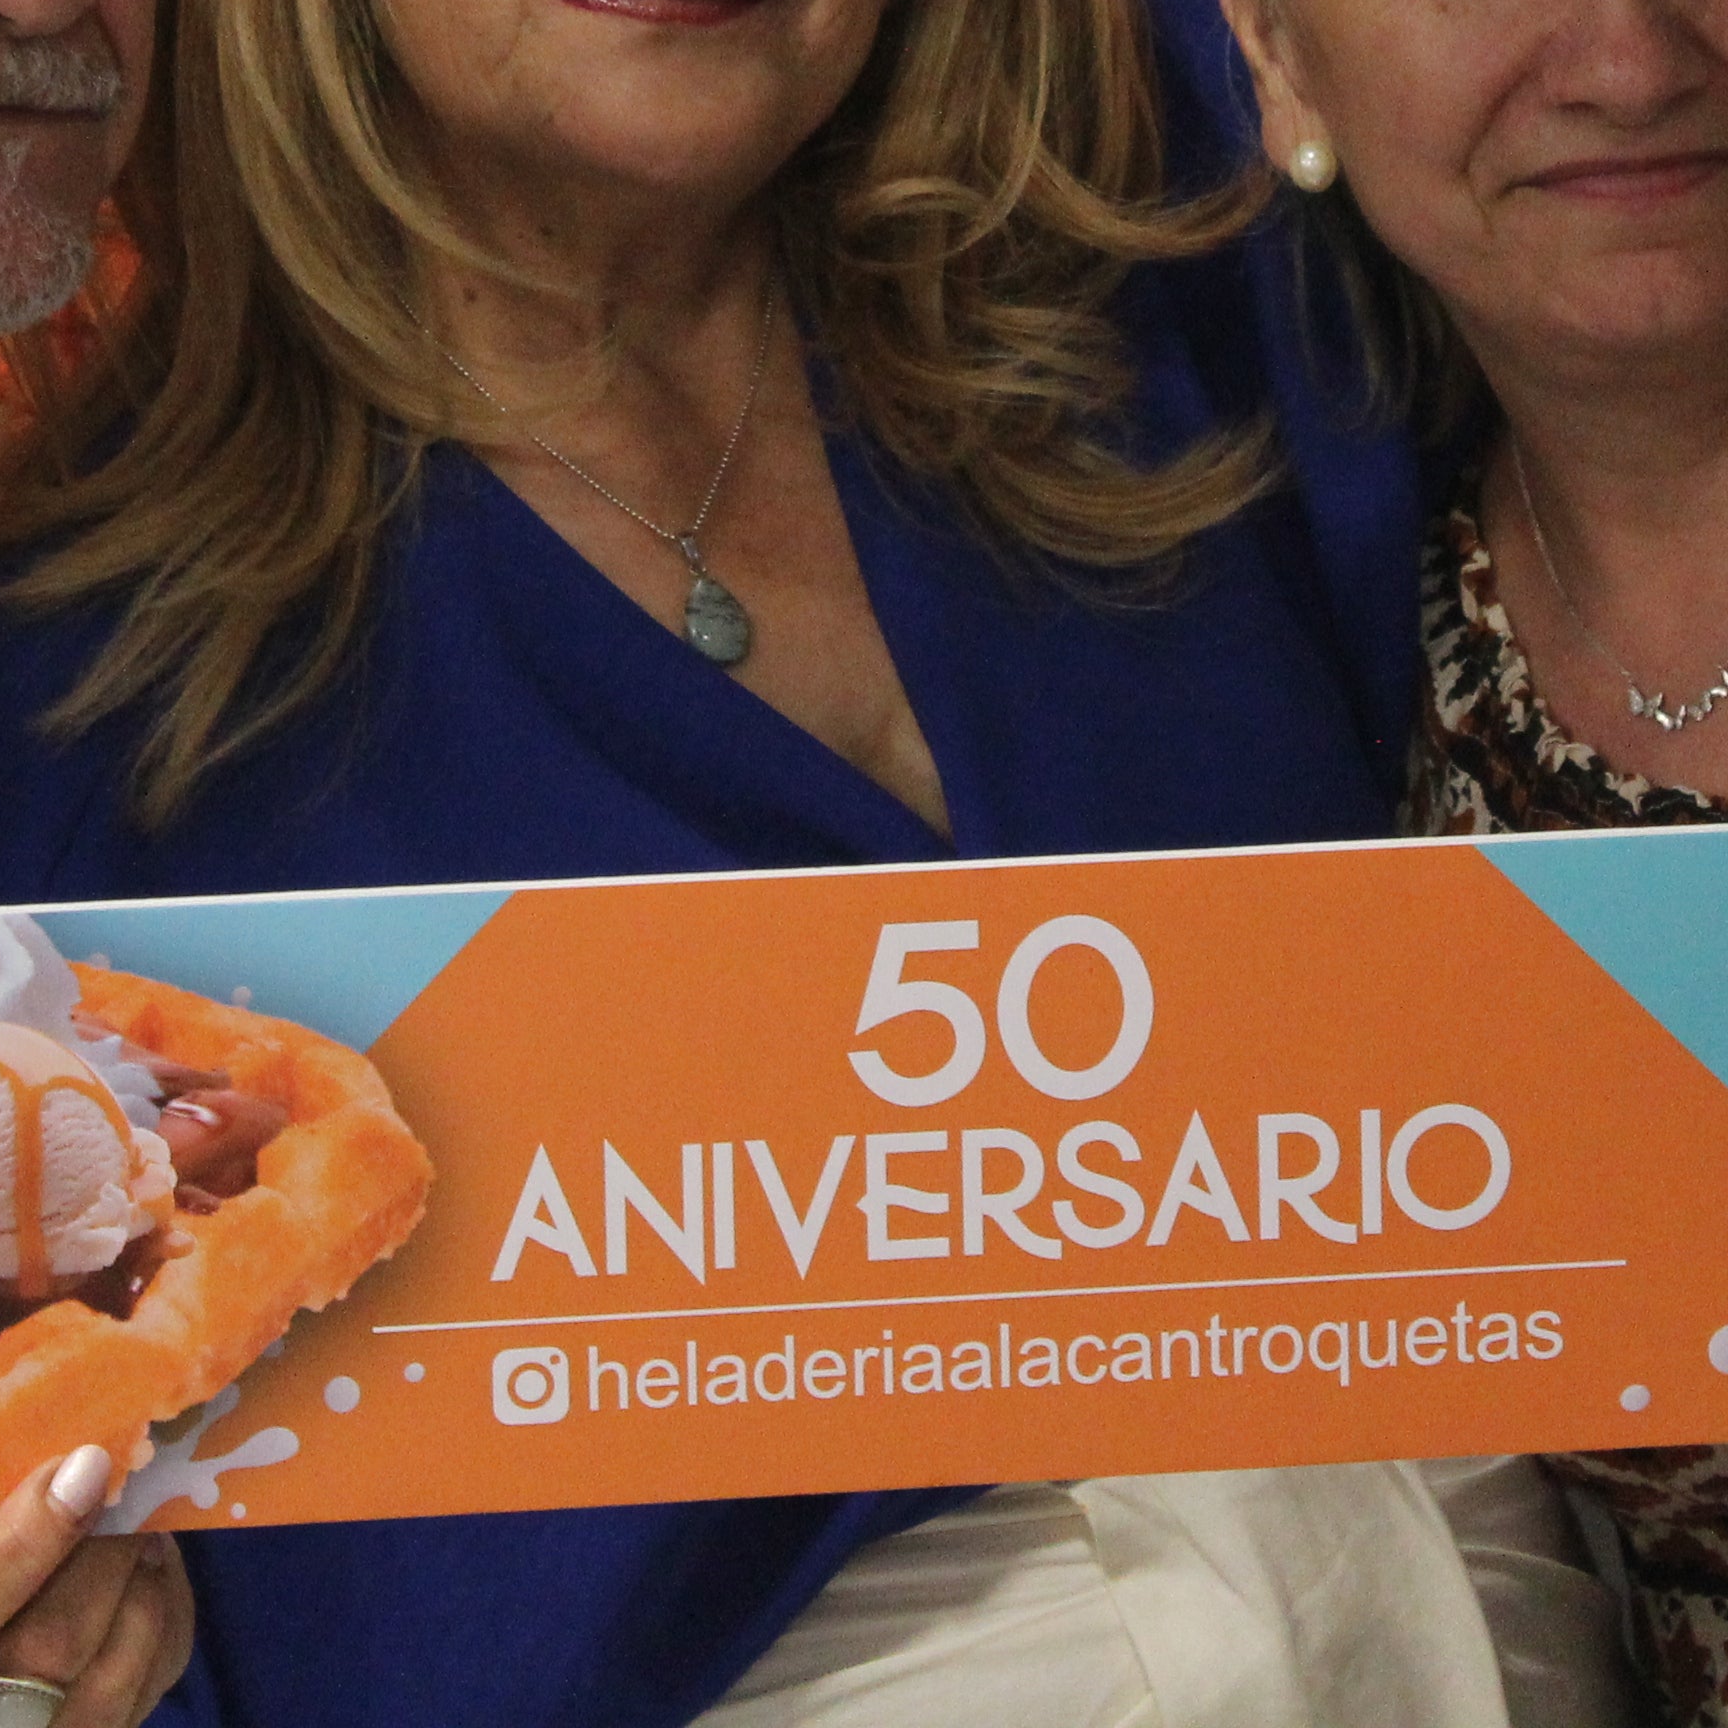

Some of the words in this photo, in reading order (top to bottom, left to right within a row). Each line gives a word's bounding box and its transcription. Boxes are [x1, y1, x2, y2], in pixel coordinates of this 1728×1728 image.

[847, 914, 1155, 1108] 50
[489, 1103, 1512, 1286] ANIVERSARIO
[587, 1300, 1564, 1412] heladeriaalacantroquetas
